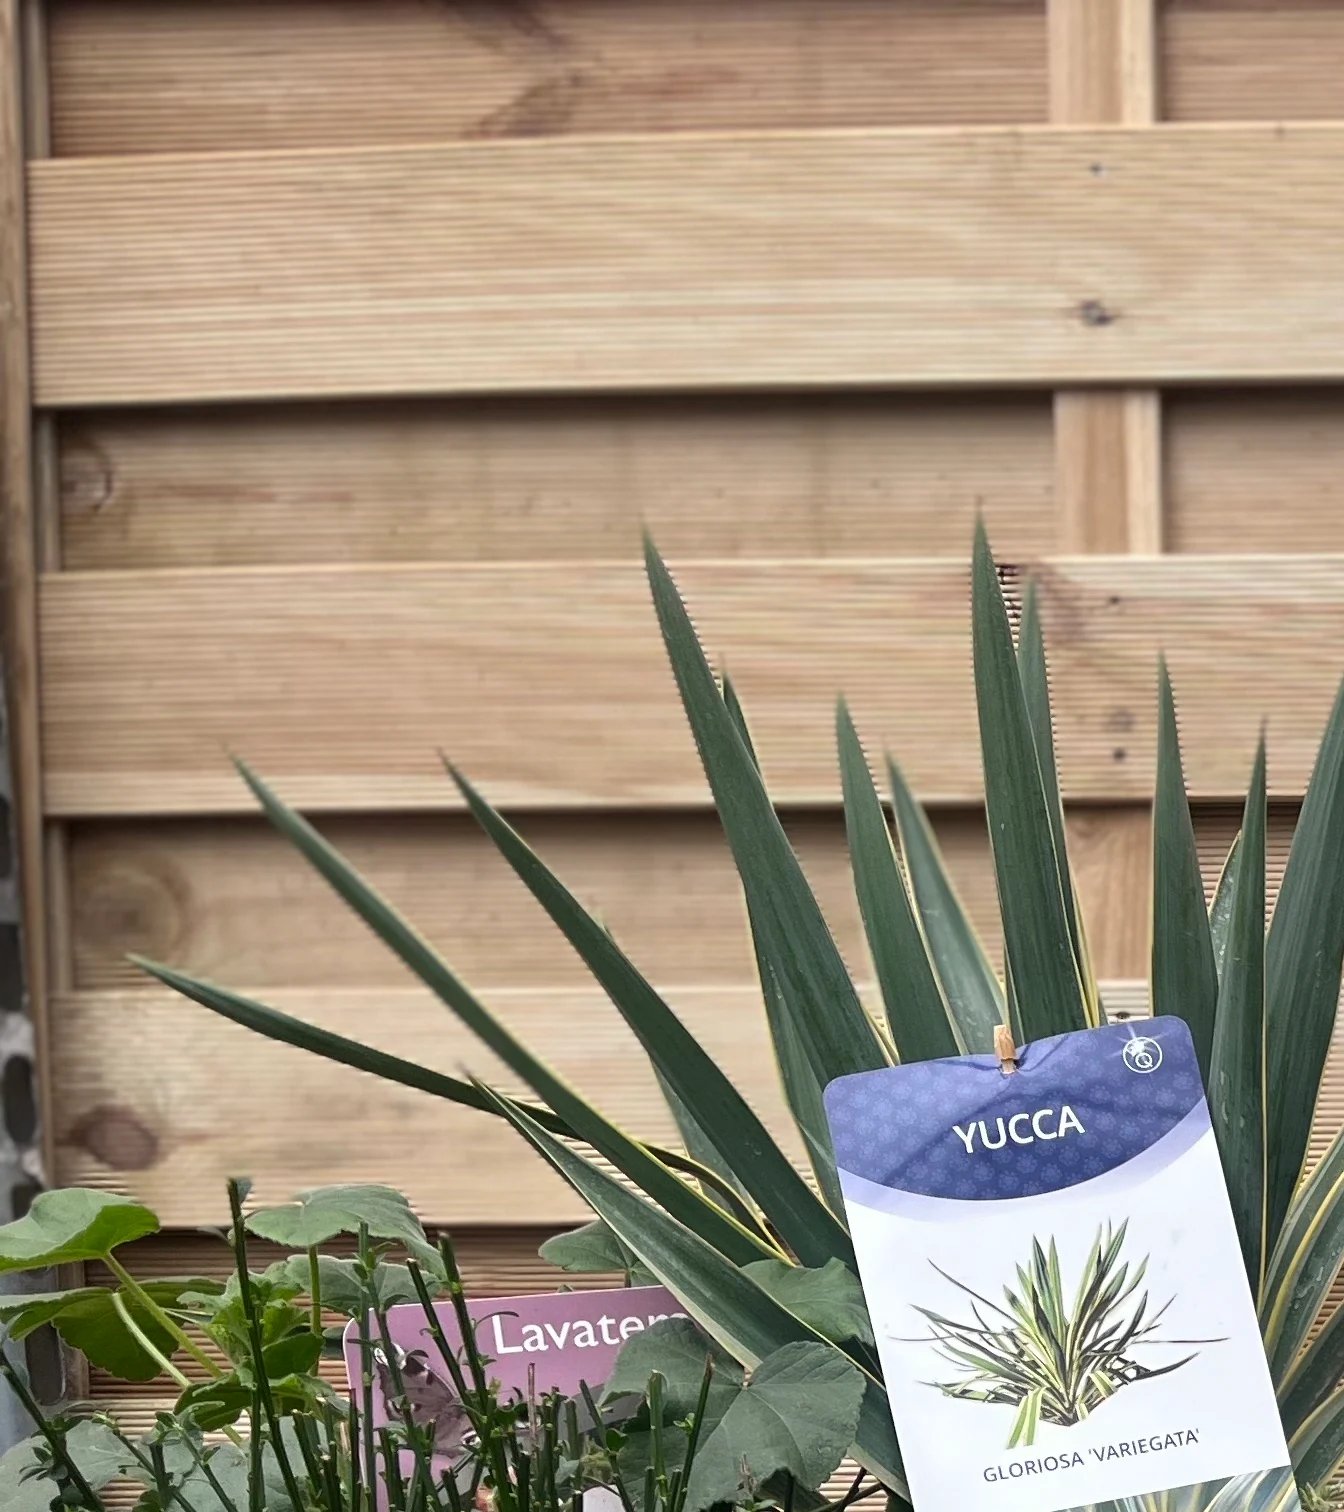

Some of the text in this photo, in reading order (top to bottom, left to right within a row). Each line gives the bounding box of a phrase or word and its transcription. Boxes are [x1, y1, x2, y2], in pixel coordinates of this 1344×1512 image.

[952, 1105, 1086, 1154] YUCCA
[491, 1312, 690, 1354] Lavate
[983, 1428, 1200, 1482] GLORIOSA 'VARIEGATA'
